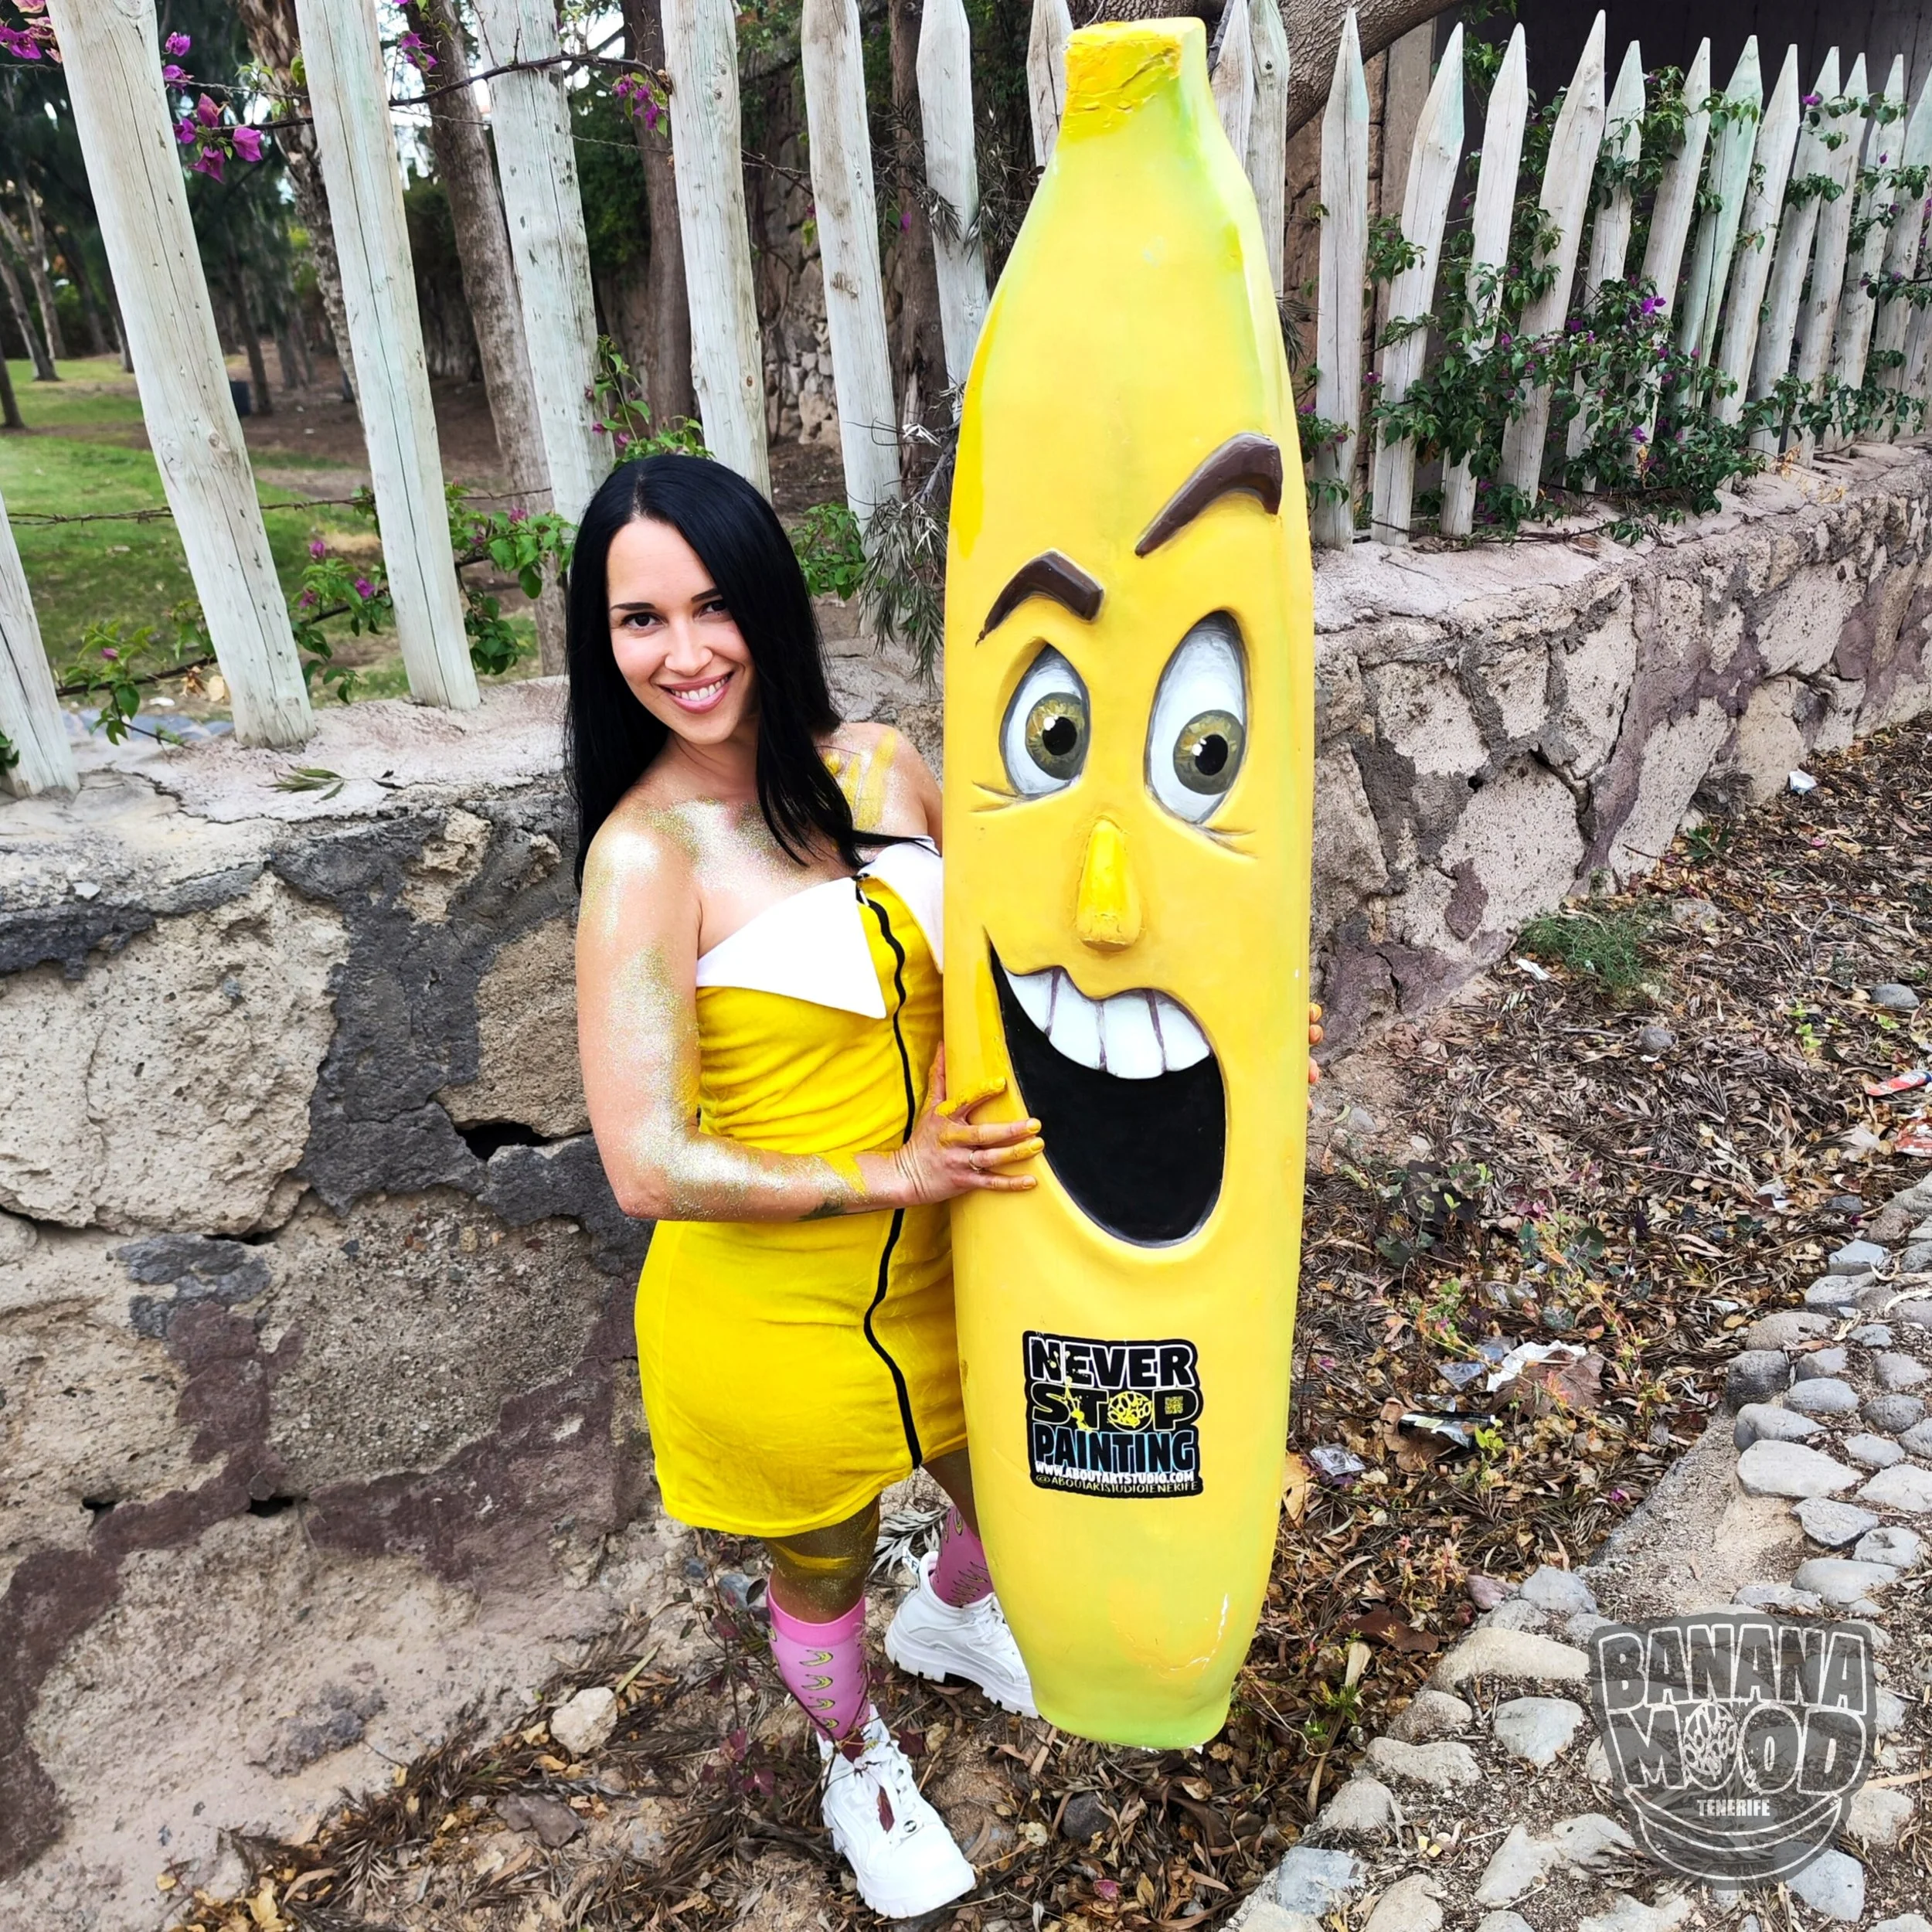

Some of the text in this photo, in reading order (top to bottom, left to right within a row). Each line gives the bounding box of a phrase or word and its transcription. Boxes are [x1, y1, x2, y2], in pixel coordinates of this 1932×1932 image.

[1029, 1336, 1196, 1389] NEVER
[1031, 1381, 1199, 1433] STOP
[1032, 1423, 1196, 1473] PAINTING
[1035, 1461, 1195, 1484] WWW.ABOUTARTSTUDIO.COM
